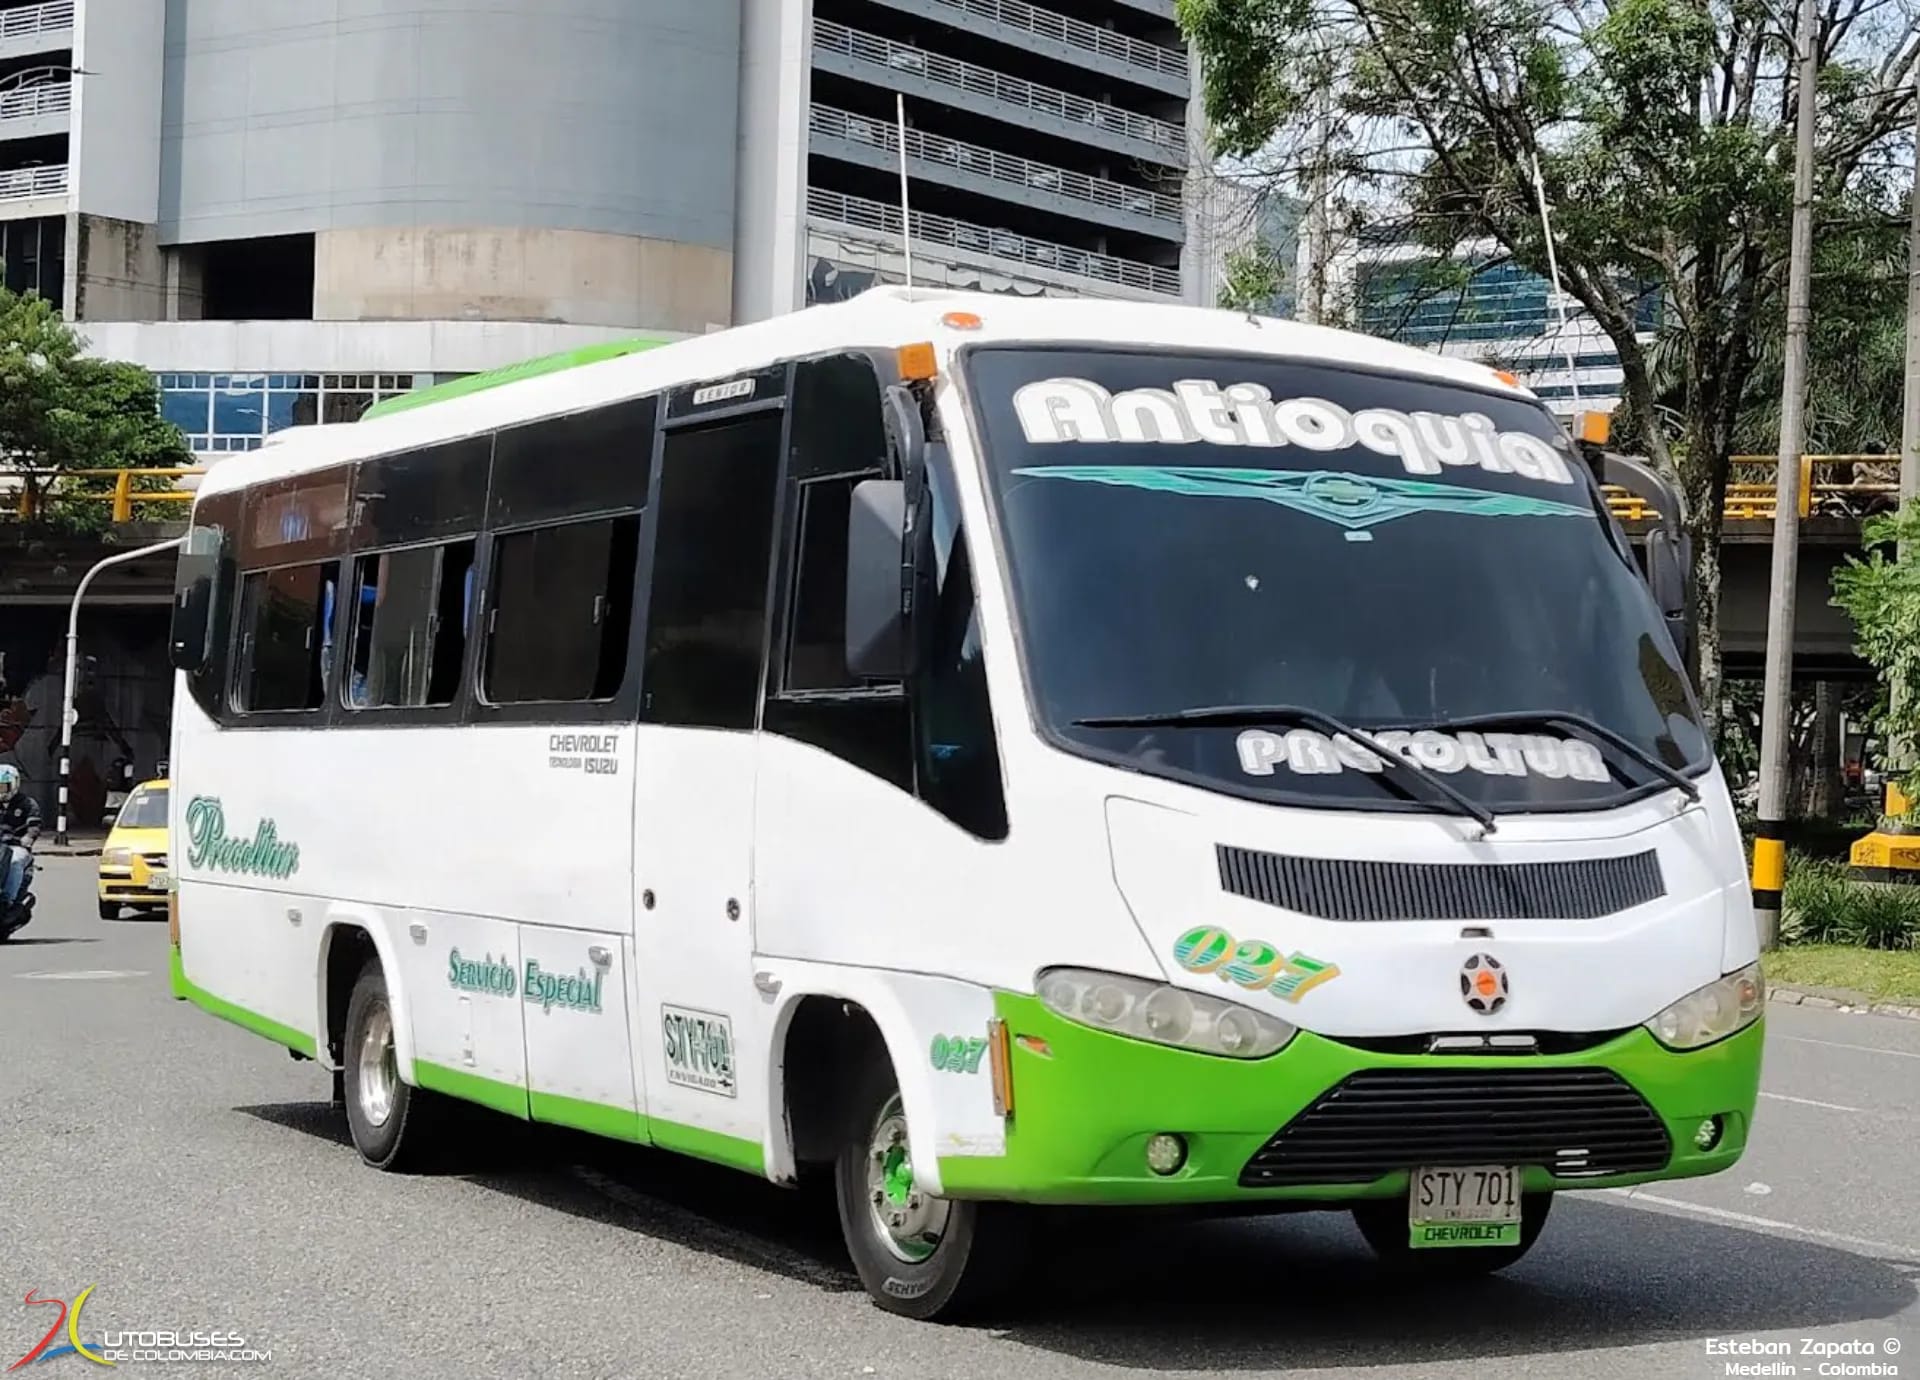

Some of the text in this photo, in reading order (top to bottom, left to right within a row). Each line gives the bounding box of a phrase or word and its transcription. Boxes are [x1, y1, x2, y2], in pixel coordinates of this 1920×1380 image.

[698, 382, 748, 402] SENIOR
[1012, 378, 1574, 484] Antioquia
[549, 735, 618, 752] CHEVROLET
[584, 757, 618, 774] ISUZU
[186, 795, 300, 880] Precoltur
[1173, 924, 1341, 1004] 027
[930, 1033, 988, 1074] 027
[1420, 1171, 1515, 1206] STY 701
[1424, 1225, 1504, 1241] CHEVROLET
